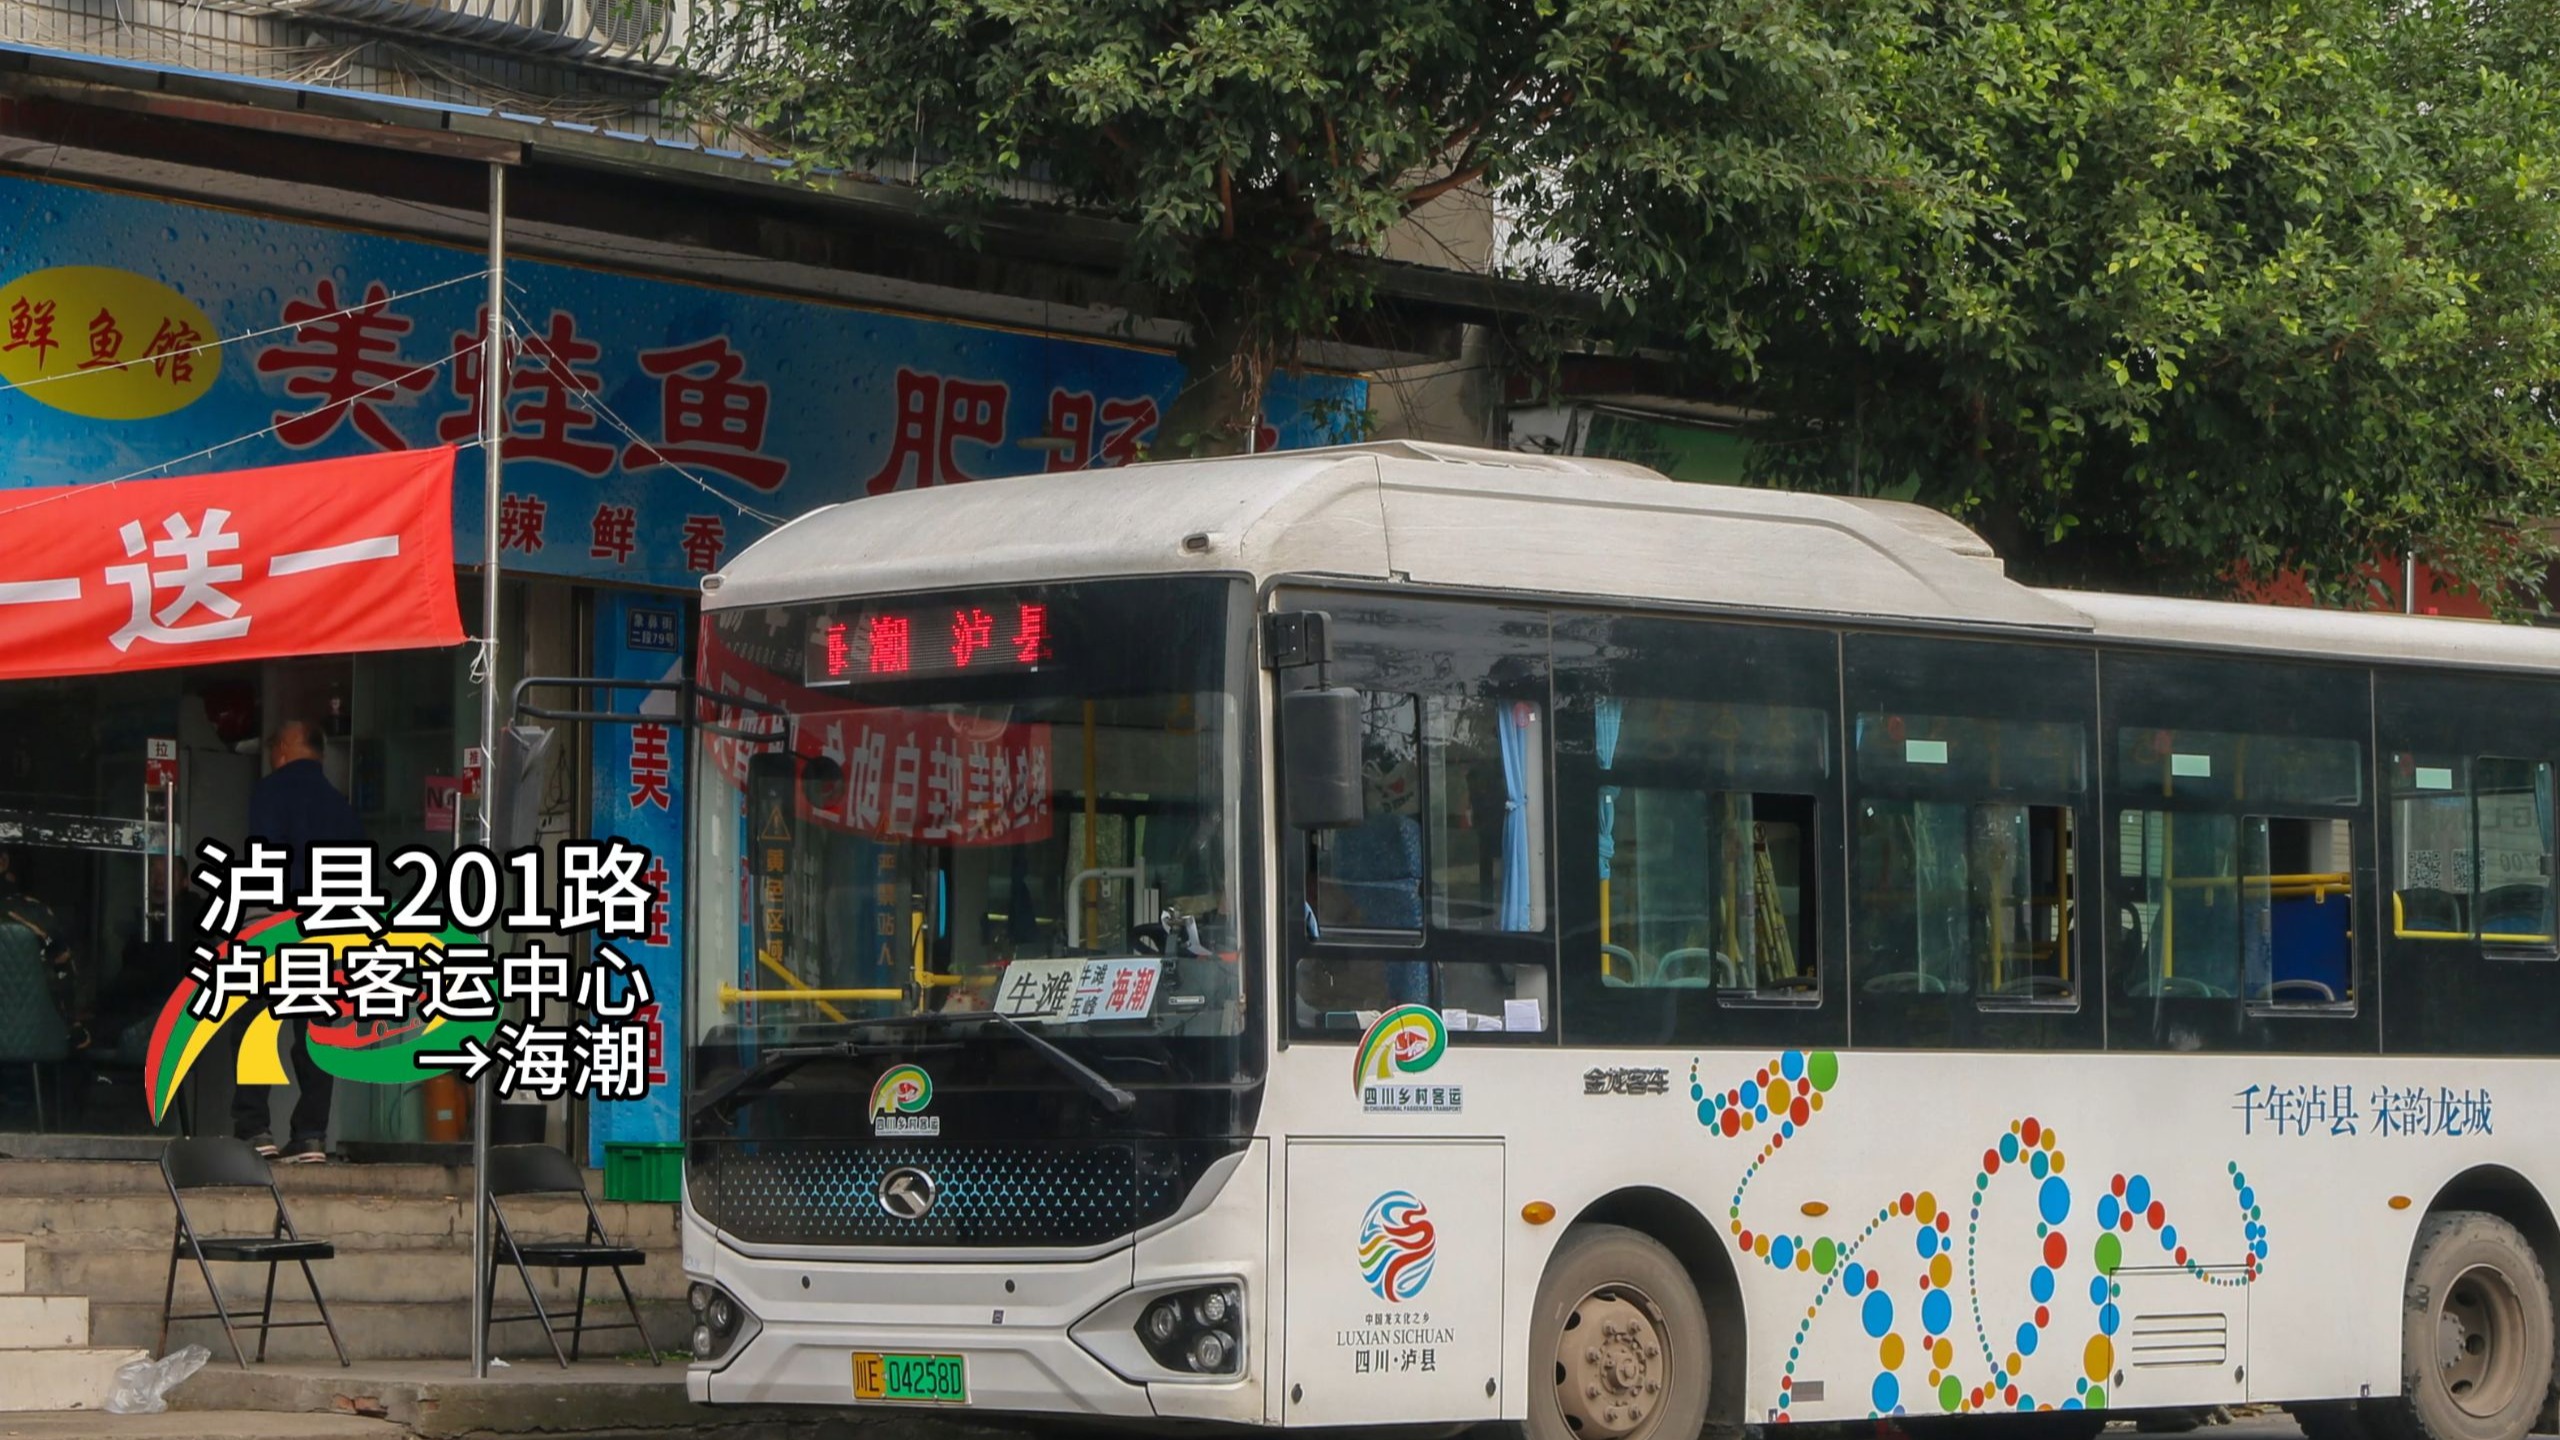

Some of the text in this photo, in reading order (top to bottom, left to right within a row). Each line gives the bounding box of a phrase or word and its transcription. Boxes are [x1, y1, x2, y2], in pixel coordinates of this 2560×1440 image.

[2, 296, 202, 386] 鲜鱼馆
[257, 278, 790, 492] 美蛙鱼
[866, 368, 1279, 496] 肥肠
[155, 741, 168, 757] 拉
[1006, 970, 1074, 1014] 牛滩
[1105, 966, 1155, 1013] 海潮
[1364, 1087, 1462, 1105] 四川乡村客运
[1583, 1067, 1669, 1095] 金龙客车
[2232, 1084, 2494, 1138] 千年泸县 宋韵龙城
[1337, 1328, 1454, 1346] LUXIAN SICHUAN
[1365, 1312, 1430, 1326] 中国龙文化之乡
